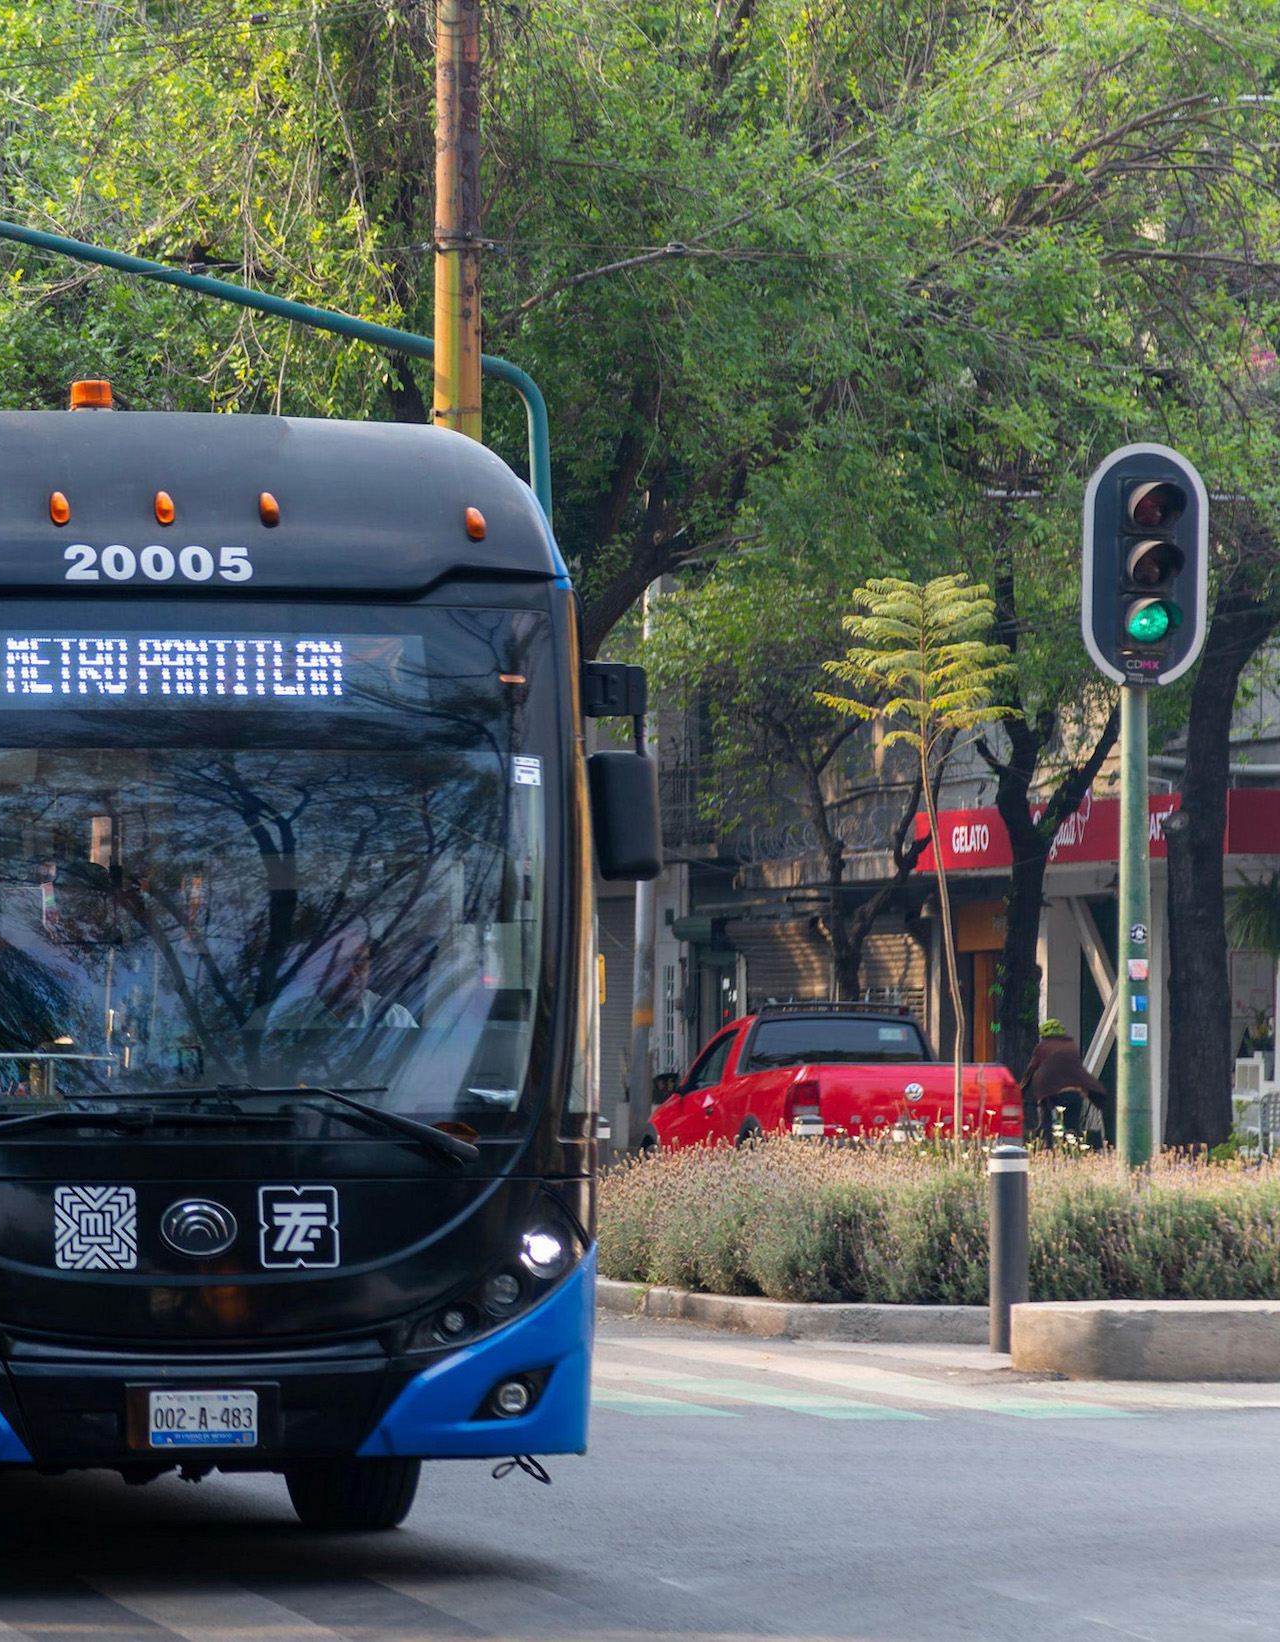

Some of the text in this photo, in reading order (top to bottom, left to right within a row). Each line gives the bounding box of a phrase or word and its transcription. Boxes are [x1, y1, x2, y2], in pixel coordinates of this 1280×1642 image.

[64, 544, 253, 582] 20005
[6, 638, 128, 694] METRO
[139, 640, 343, 696] PANTITLAN
[1125, 659, 1160, 670] CDMX
[952, 824, 989, 853] GELATO
[154, 1407, 253, 1430] 002-A-483
